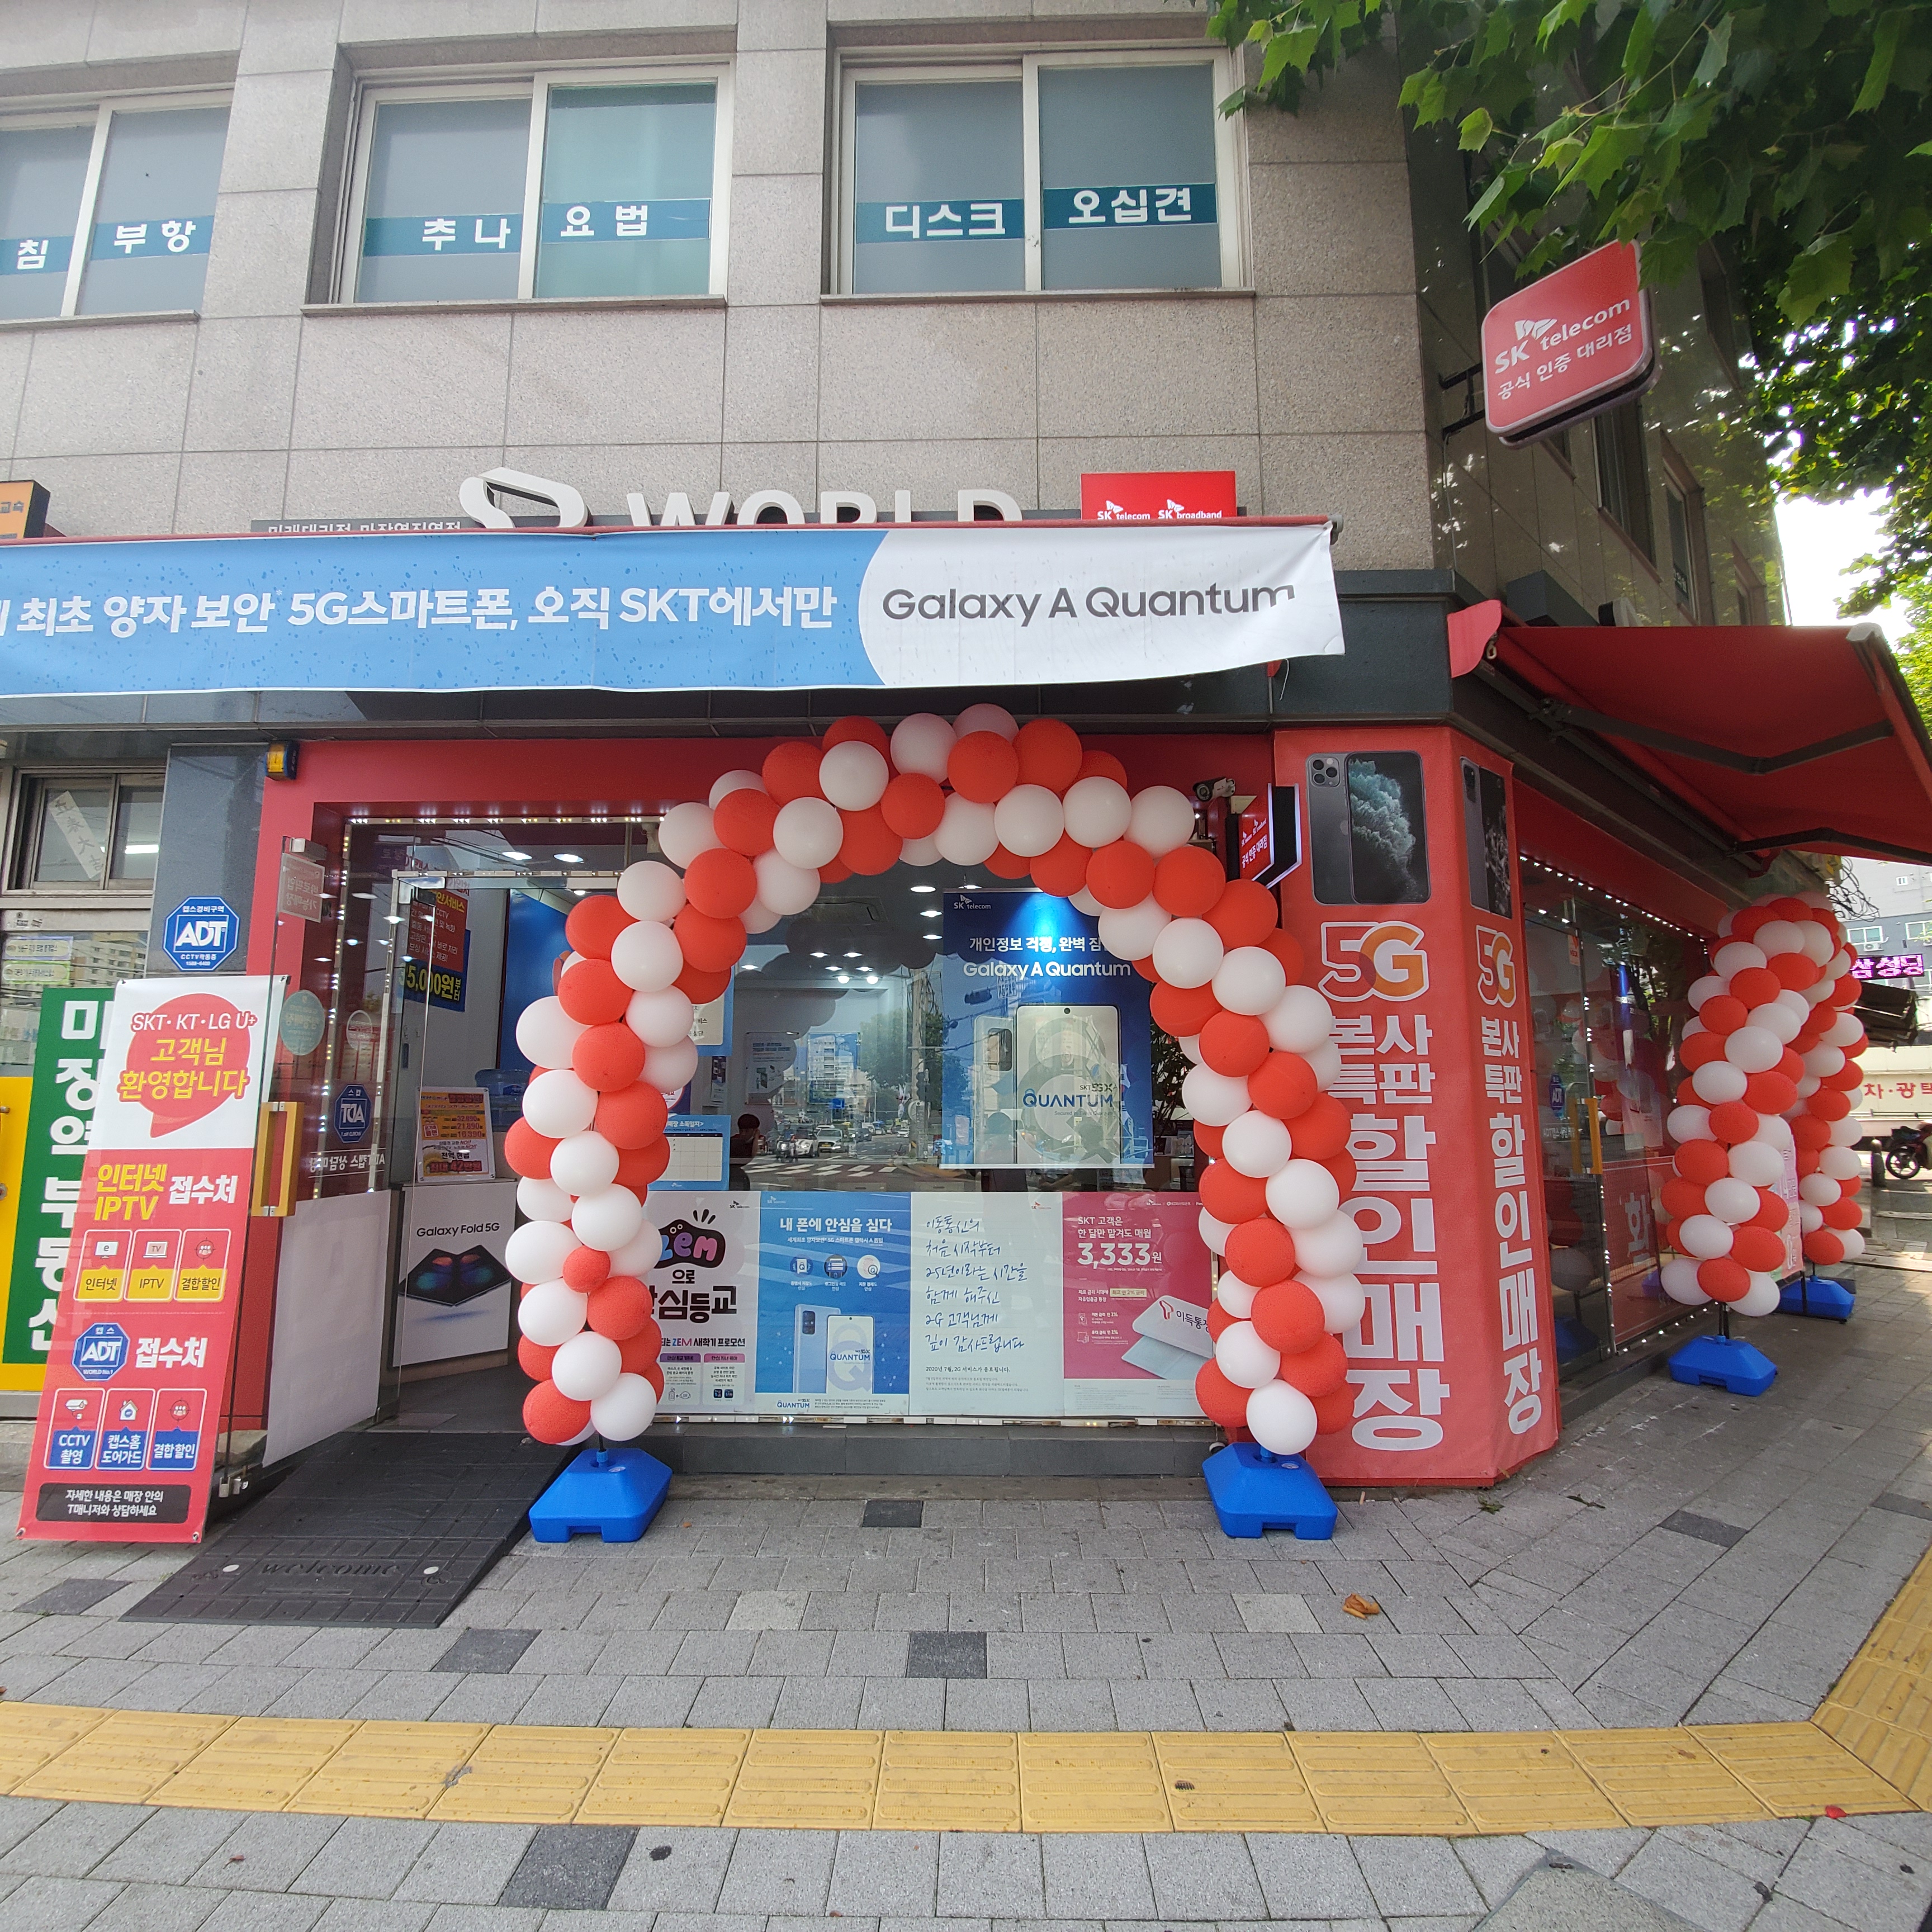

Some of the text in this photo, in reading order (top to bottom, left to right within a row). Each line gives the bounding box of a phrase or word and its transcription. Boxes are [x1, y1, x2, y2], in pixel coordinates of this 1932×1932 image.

[1068, 187, 1191, 224] 오십견
[422, 205, 648, 251] 추나 요법
[886, 202, 1006, 239] 디스크
[113, 220, 196, 254] 부항
[17, 239, 49, 270] 침
[1495, 299, 1630, 374] SK telecom
[1498, 323, 1632, 400] 공식 인증 대리점
[1097, 511, 1112, 520] SK
[1158, 509, 1223, 519] SK broadband
[16, 596, 94, 637] 최초
[103, 595, 187, 639] 양자
[528, 586, 610, 631] 오직
[619, 586, 837, 629] SKT에서만
[882, 583, 1295, 627] Galaxy A Quantum
[436, 891, 465, 913] 안서비스
[175, 921, 228, 946] ADT
[969, 937, 1024, 953] 개인정보
[1058, 937, 1086, 951] 완벽
[963, 961, 1131, 980] Galaxy A Quantum
[1318, 921, 1429, 1002] 5G
[1475, 925, 1517, 1008] 5G
[1481, 1016, 1520, 1059] 본사
[150, 1037, 228, 1066] 고객님
[119, 1070, 247, 1100] 환영합니다
[1484, 1064, 1523, 1104] 특판
[1022, 1092, 1114, 1108] QUANTUM
[94, 1163, 168, 1192] 인터넷
[169, 1174, 238, 1204] 접수처
[94, 1196, 159, 1221] IPTV
[416, 1222, 500, 1237] Galaxy Fold 5G
[780, 1218, 893, 1233] 내 폰에 안심을 심다
[926, 1214, 980, 1234] 이동통신의
[1078, 1216, 1123, 1227] SKT 고객은
[1077, 1229, 1152, 1239] 한 달만 맡겨도 매월
[926, 1239, 1001, 1257] 처음 시작부터
[1077, 1243, 1163, 1270] 3,333원
[672, 1269, 695, 1284] 으로
[925, 1262, 1028, 1281] 25년이라는 시간을
[1489, 1112, 1542, 1435] 할인매장
[85, 1277, 117, 1291] 인터넷
[139, 1278, 164, 1289] IPTV
[181, 1277, 221, 1292] 결합할인
[1338, 1112, 1451, 1452] 할인매장
[925, 1286, 1001, 1305] 함께 해주신
[925, 1311, 998, 1328] 2G 고객님께
[80, 1342, 122, 1362] ADT
[673, 1338, 746, 1347] ZEM 새학기 프로모션
[925, 1334, 1025, 1353] 깊이 감사드립니다
[135, 1337, 209, 1368] 접수처
[58, 1434, 91, 1447] CCTV
[108, 1434, 141, 1448] 캡스홈
[60, 1450, 83, 1465] 촬영
[101, 1450, 142, 1465] 도어가드
[154, 1443, 195, 1459] 결합할인
[65, 1489, 164, 1503] 자세한 내용은 매장 안의
[67, 1503, 158, 1518] T매니저와 상담하세요
